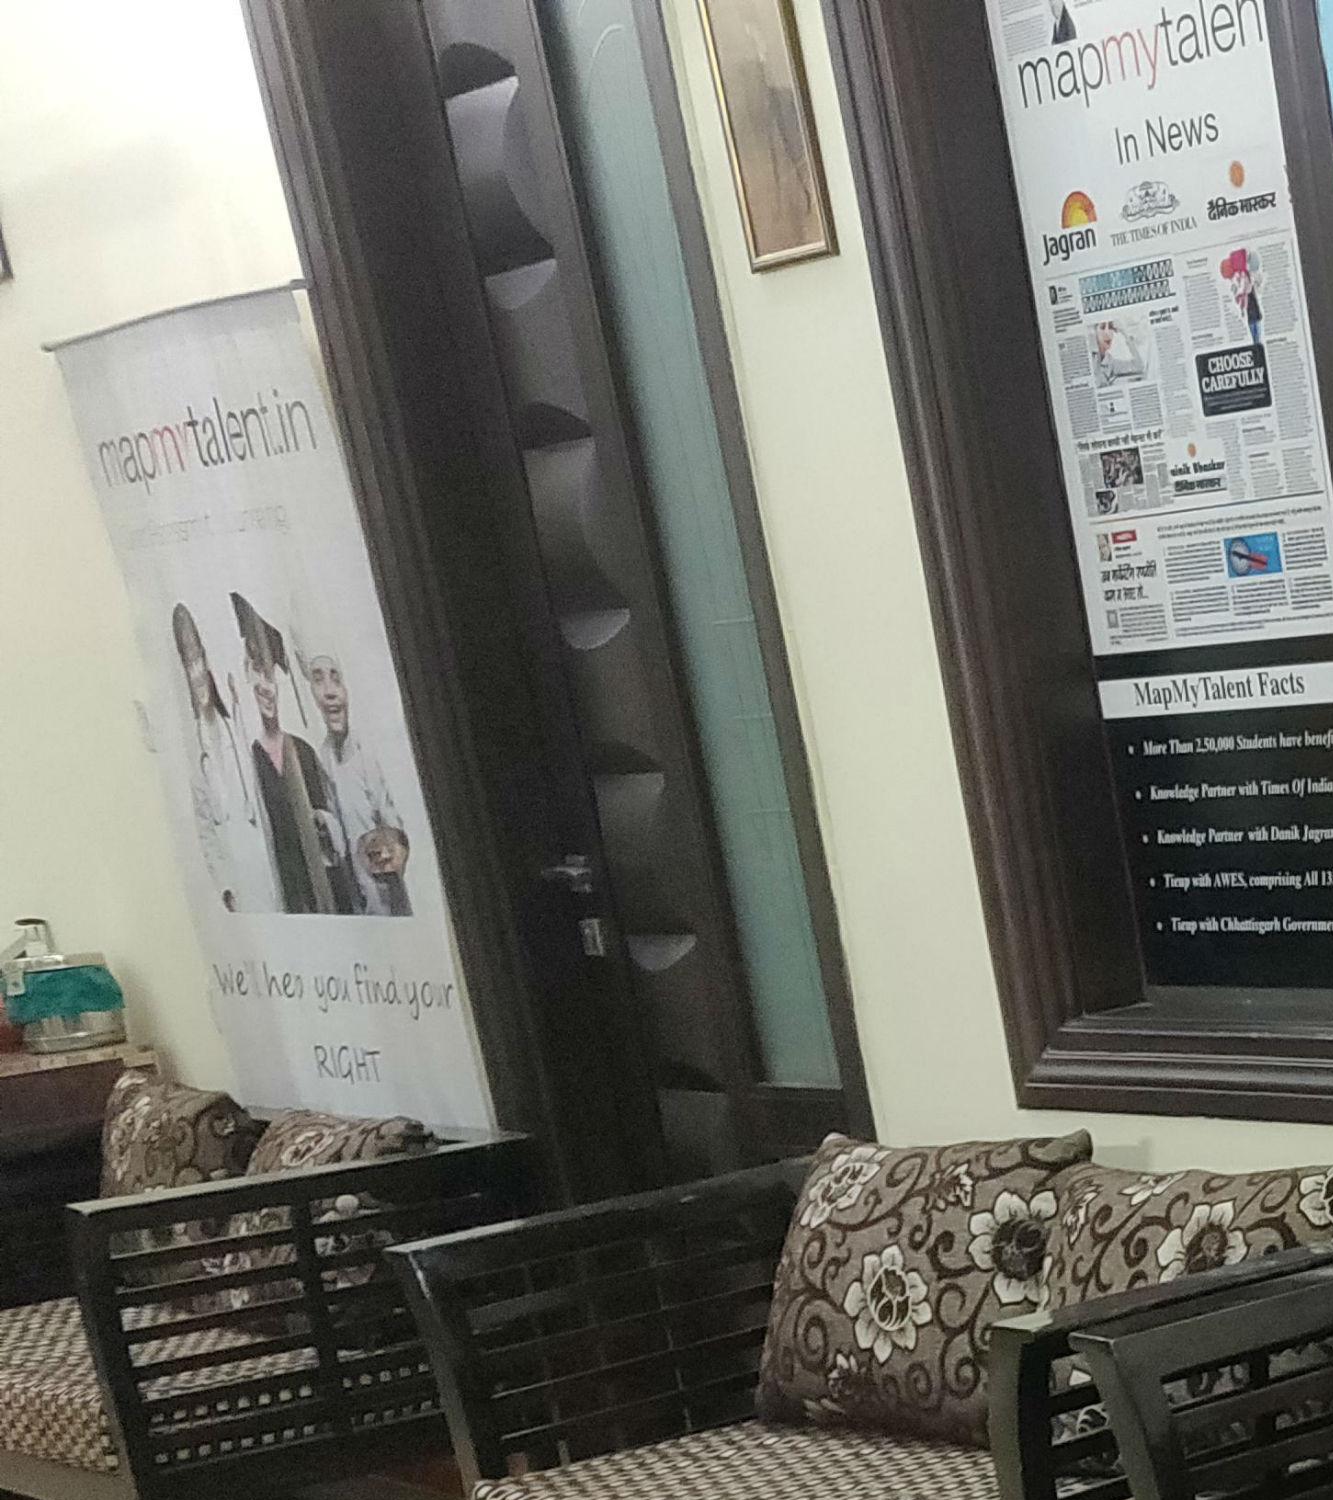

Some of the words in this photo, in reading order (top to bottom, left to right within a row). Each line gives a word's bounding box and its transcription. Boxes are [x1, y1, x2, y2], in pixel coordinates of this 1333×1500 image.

[1115, 127, 1140, 165] In
[1146, 113, 1219, 157] News
[1110, 231, 1129, 247] THE
[1130, 226, 1157, 244] TIMES
[1157, 223, 1169, 240] OF
[1170, 216, 1198, 236] INDIA
[1043, 228, 1097, 266] Jagran
[1207, 351, 1255, 374] CHOOSE
[1201, 367, 1265, 393] CAREFULLY
[1133, 676, 1253, 711] MapMyTalent
[1257, 671, 1306, 697] Facts
[1143, 740, 1168, 756] More
[1169, 739, 1194, 755] Than
[1236, 733, 1277, 750] Students
[1279, 731, 1302, 748] have
[1150, 784, 1199, 802] Knowledge
[1201, 782, 1237, 798] Partner
[1238, 780, 1259, 797] with
[1260, 779, 1290, 796] Times
[1292, 777, 1306, 798] Of
[1307, 777, 1333, 794] India
[1157, 829, 1206, 846] Knowledge
[1208, 828, 1243, 843] Partner
[1248, 826, 1269, 842] with
[1192, 873, 1212, 887] with
[1249, 871, 1302, 890] comprising
[1303, 870, 1318, 886] All
[1199, 917, 1219, 932] with
[314, 1044, 381, 1083] RIGHT
